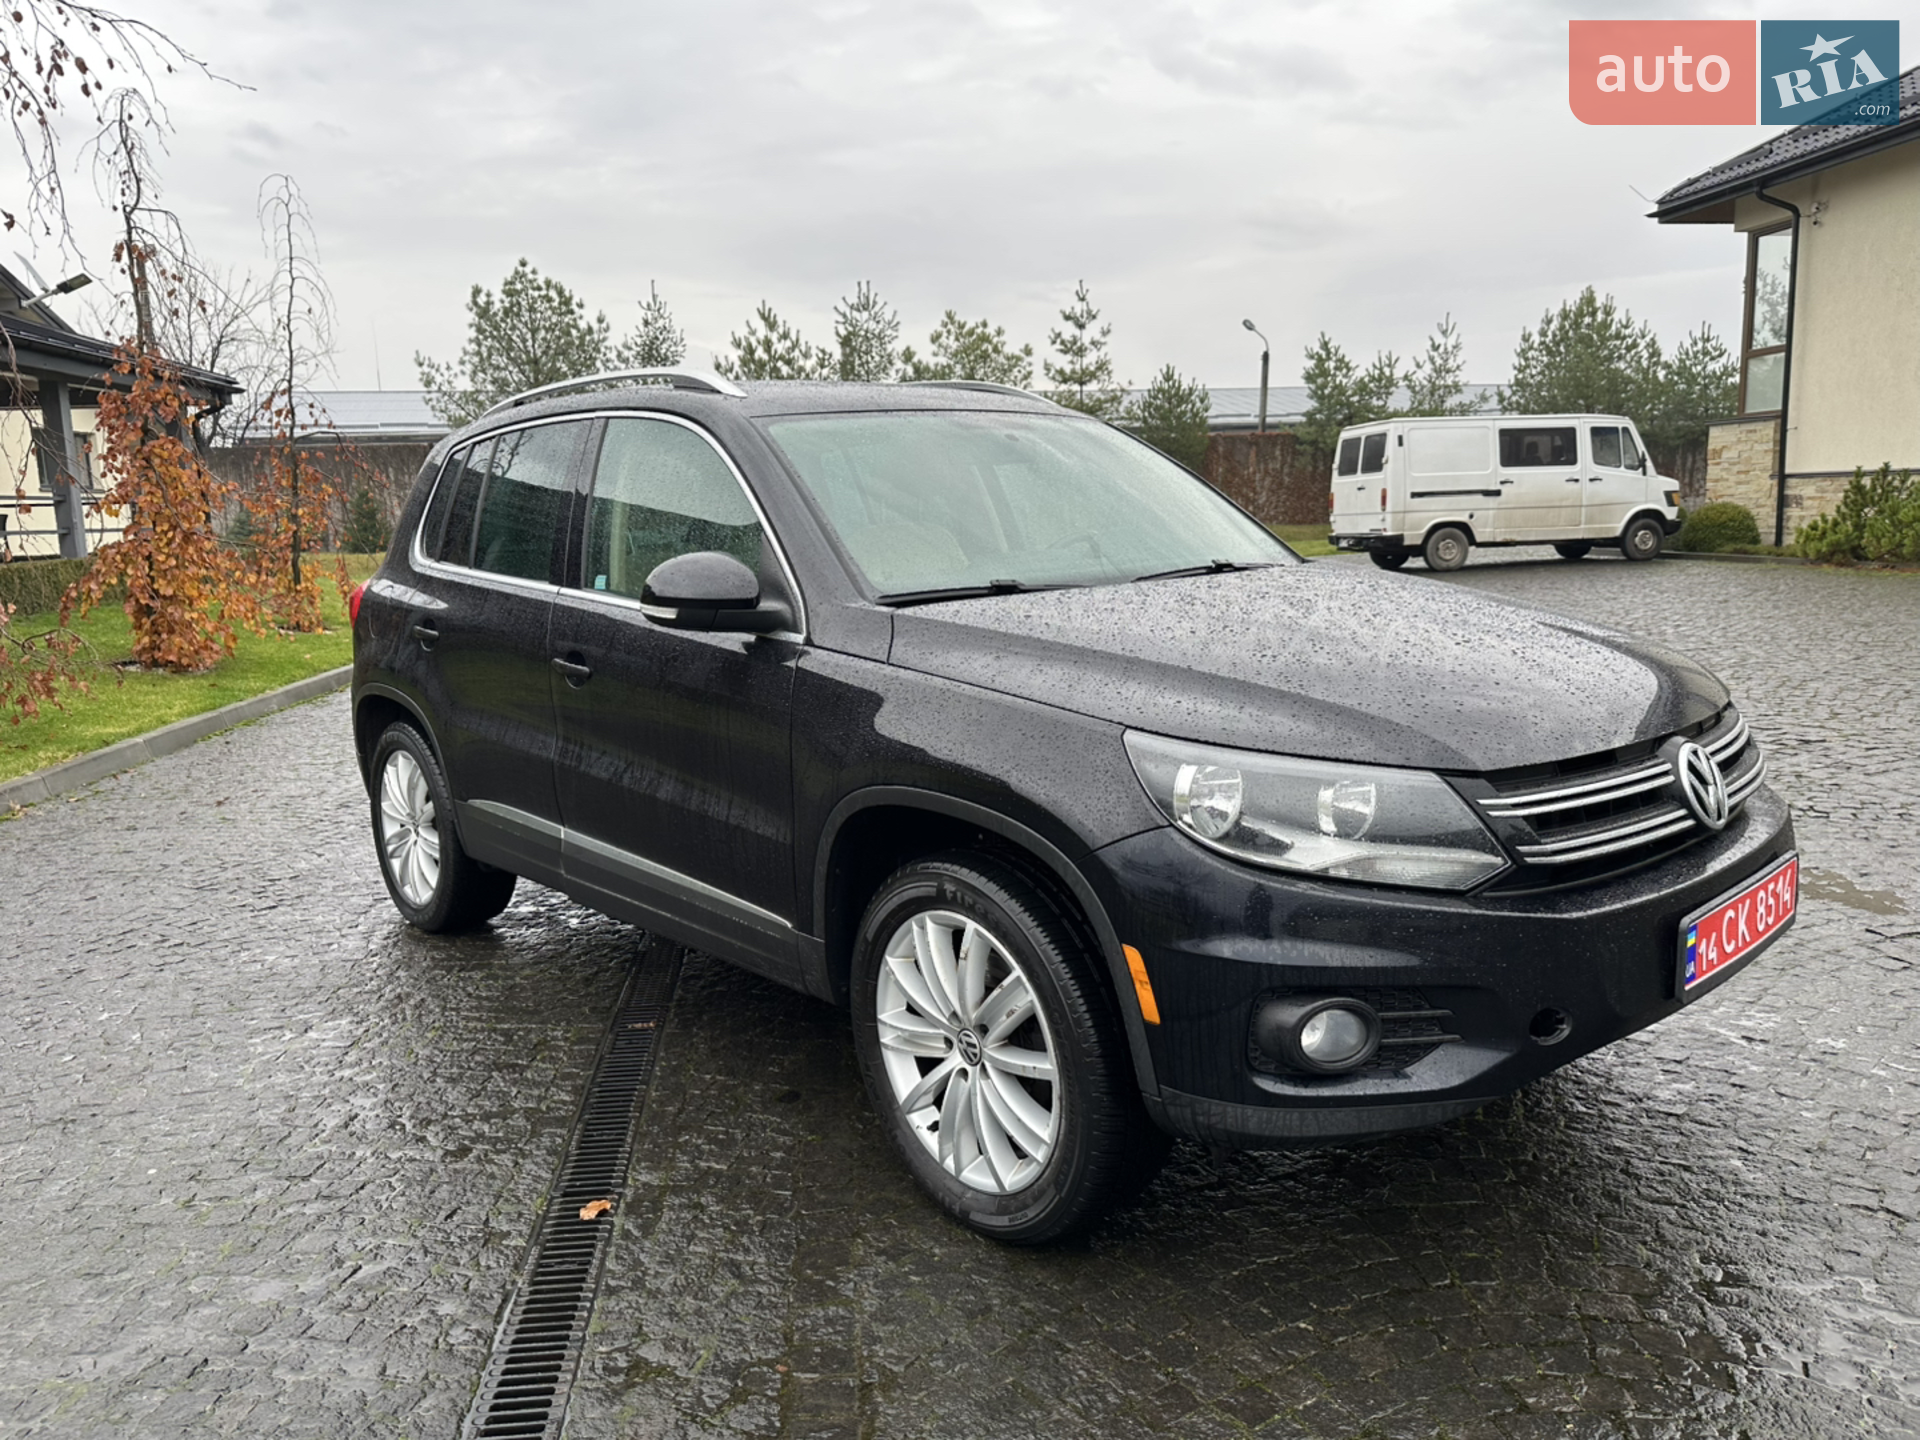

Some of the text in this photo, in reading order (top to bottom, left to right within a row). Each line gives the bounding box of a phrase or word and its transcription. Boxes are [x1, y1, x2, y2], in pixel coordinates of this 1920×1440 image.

[1698, 868, 1792, 972] 14 CK 8514
[1685, 960, 1696, 978] UA
